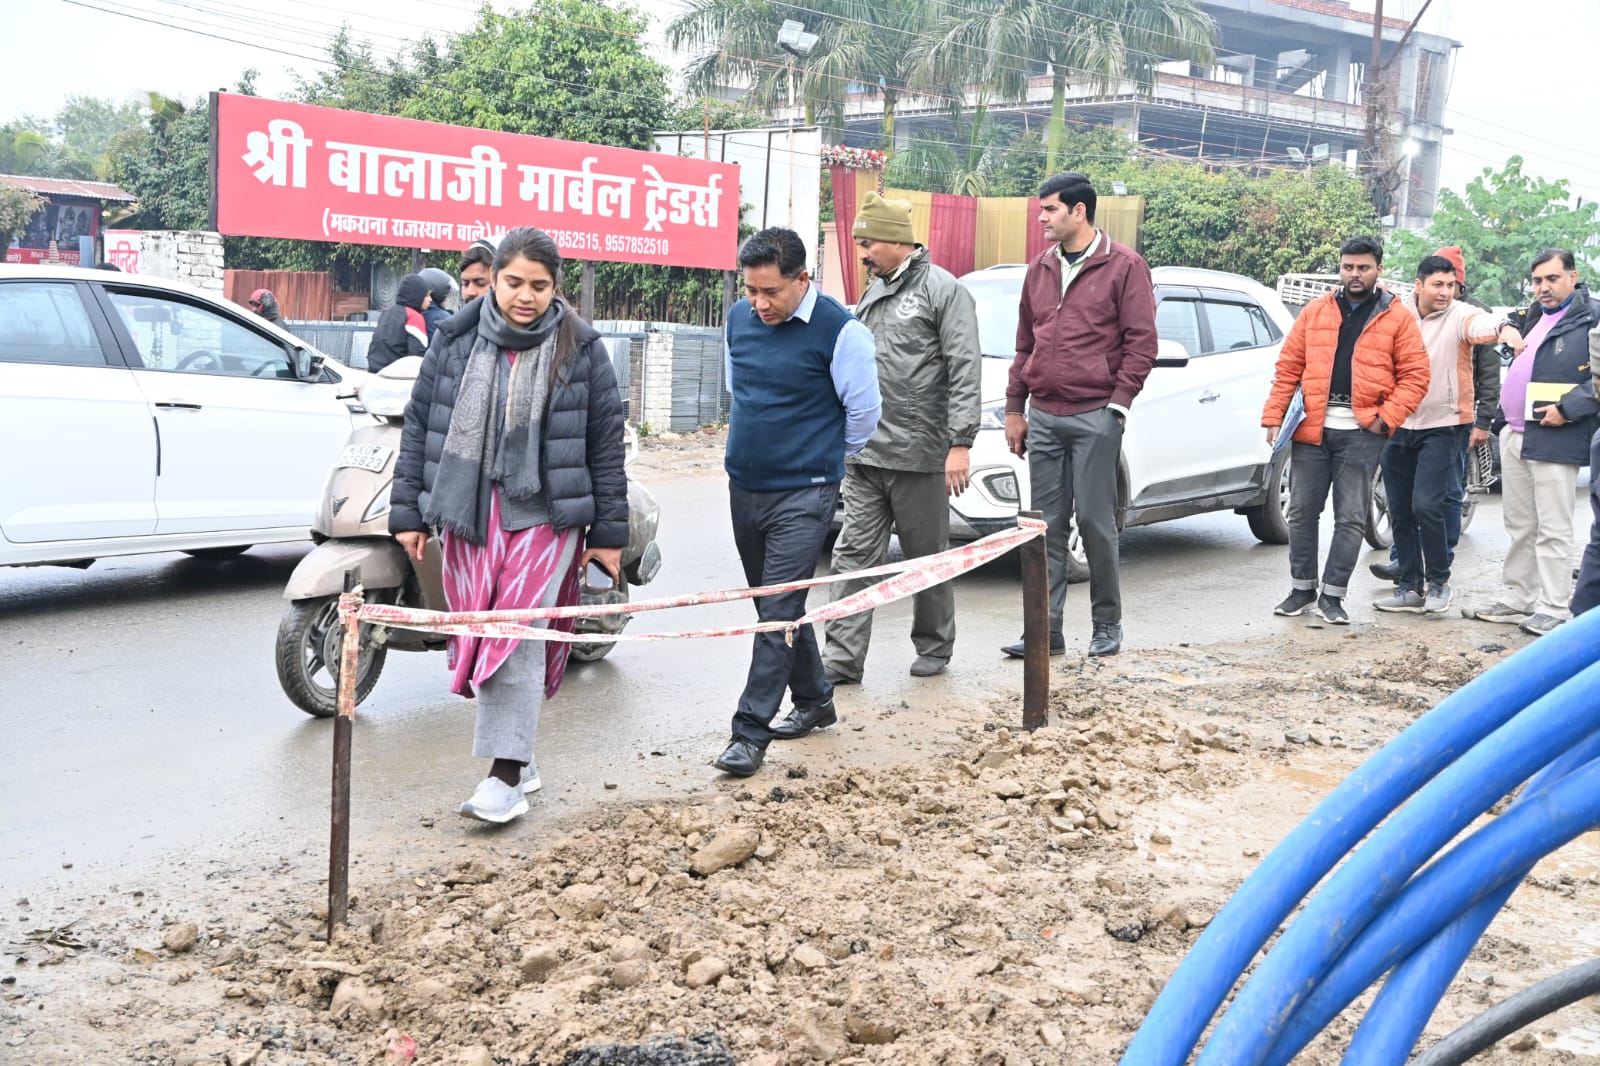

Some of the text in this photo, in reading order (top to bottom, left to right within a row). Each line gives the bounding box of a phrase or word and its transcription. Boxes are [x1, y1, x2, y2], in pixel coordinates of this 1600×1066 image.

[241, 118, 723, 233] श्री बालाजी मार्बल ट्रेडर्स
[322, 207, 388, 236] (मकराना
[391, 218, 453, 241] राजस्थान
[605, 234, 668, 256] 9557852510
